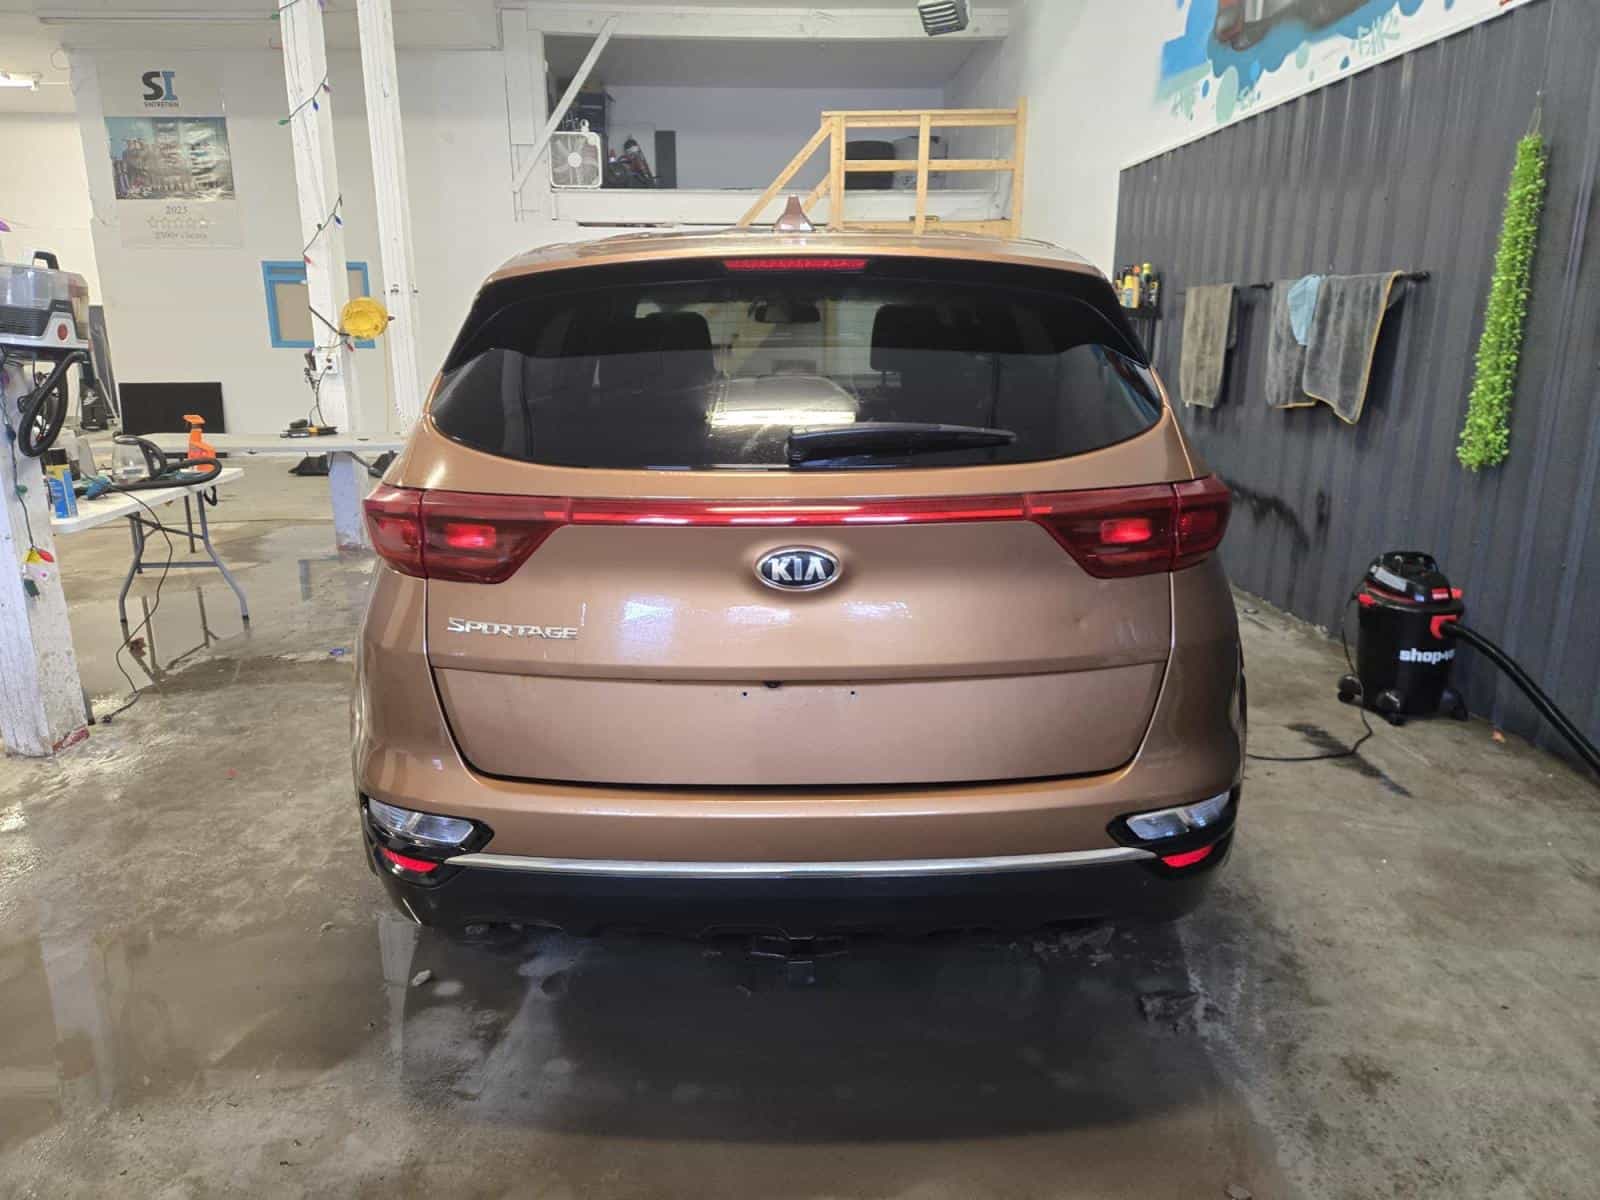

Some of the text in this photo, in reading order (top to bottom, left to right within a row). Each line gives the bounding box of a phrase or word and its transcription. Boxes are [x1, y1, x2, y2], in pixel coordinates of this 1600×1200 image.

[142, 71, 178, 101] SI
[769, 556, 829, 582] KIA
[447, 616, 578, 640] SPORTAGE
